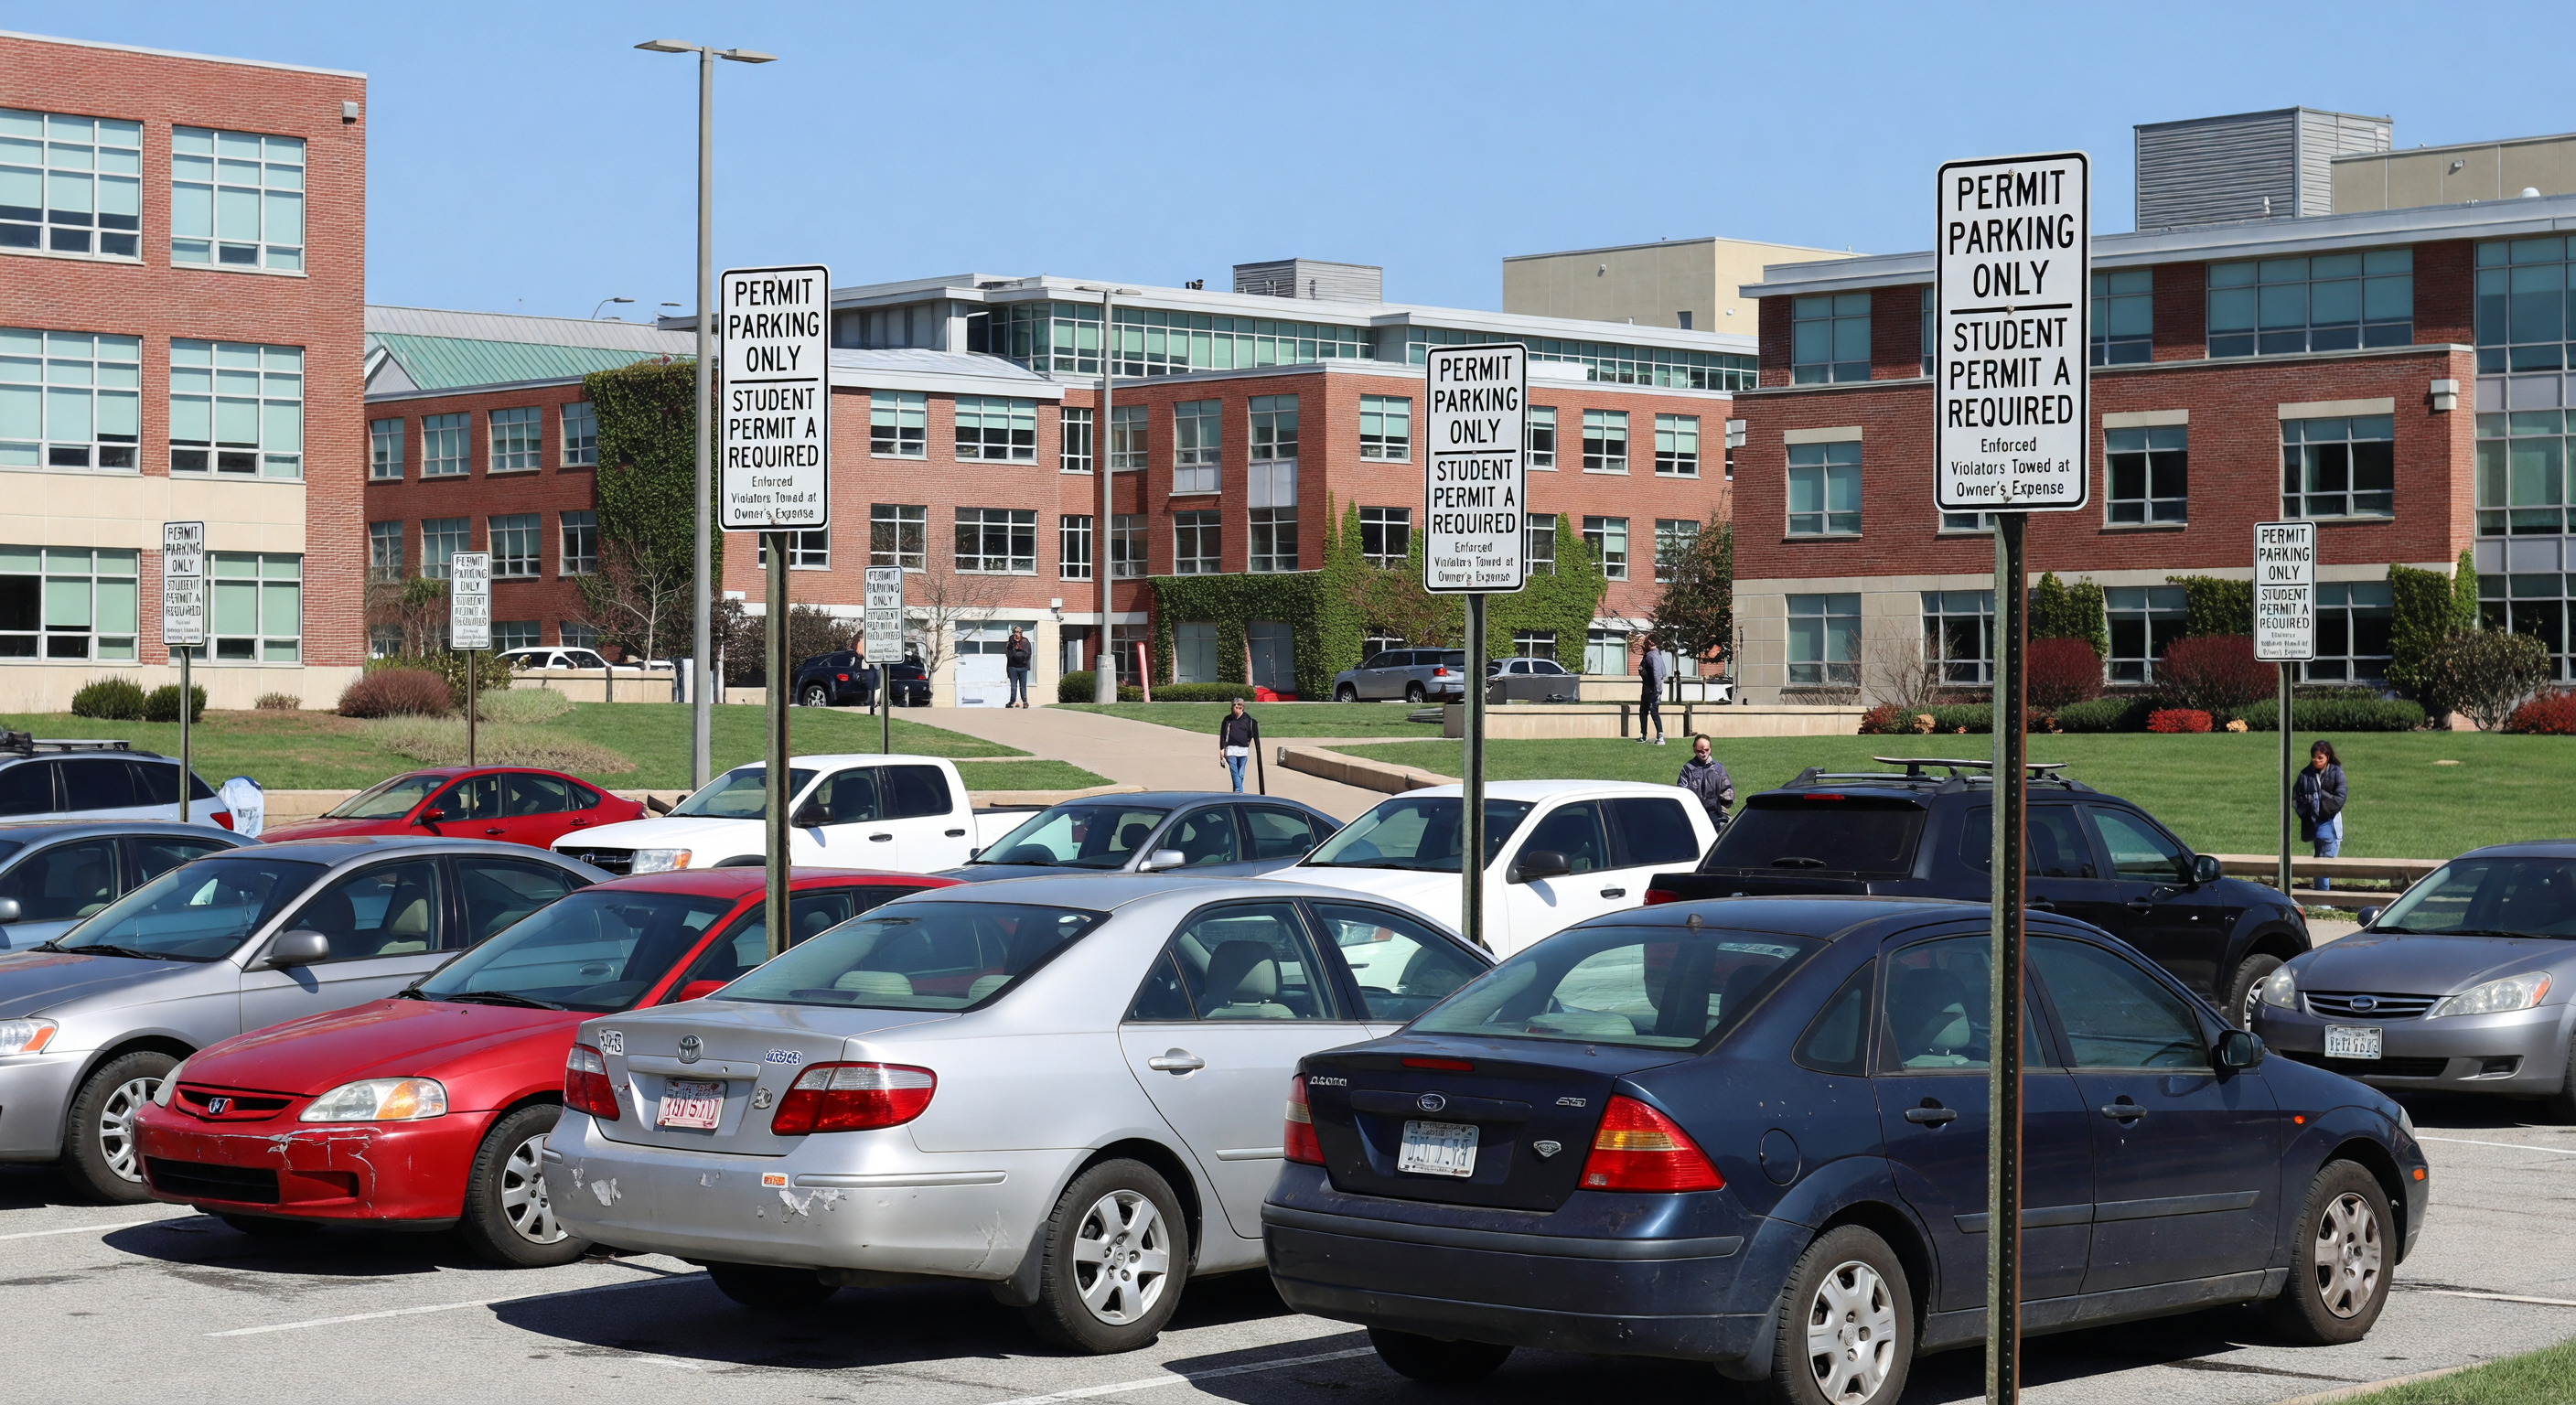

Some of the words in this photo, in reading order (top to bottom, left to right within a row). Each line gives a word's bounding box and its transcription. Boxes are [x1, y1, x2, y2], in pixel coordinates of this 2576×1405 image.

[1958, 169, 2066, 211] PERMIT
[1949, 213, 2074, 255] PARKING
[1973, 259, 2050, 298] ONLY
[735, 278, 813, 306] PERMIT
[729, 311, 819, 339] PARKING
[1953, 317, 2067, 352] STUDENT
[746, 345, 801, 372] ONLY
[1440, 356, 1512, 382] PERMIT
[1950, 357, 2042, 390] PERMIT
[2053, 357, 2071, 386] A
[733, 388, 815, 412] STUDENT
[1434, 387, 1518, 413] PARKING
[1948, 394, 2073, 428] REQUIRED
[730, 417, 796, 440] PERMIT
[805, 416, 817, 438] A
[1450, 418, 1501, 445] ONLY
[1981, 436, 2036, 453] Enforced
[729, 445, 819, 468] REQUIRED
[1951, 461, 2005, 476] Violators
[2012, 458, 2051, 474] Towed
[2057, 458, 2070, 472] at
[1437, 459, 1513, 481] STUDENT
[752, 476, 793, 488] Enforced
[1957, 481, 2007, 497] Owner's
[2012, 480, 2065, 499] Expense
[807, 492, 817, 502] at
[1434, 487, 1496, 508] PERMIT
[1504, 486, 1515, 507] A
[1433, 513, 1516, 534] REQUIRED
[2261, 528, 2306, 543] PERMIT
[166, 542, 201, 556] PARKING
[2259, 547, 2310, 562] PARKING
[172, 559, 194, 573] ONLY
[2269, 565, 2300, 581] ONLY
[460, 581, 480, 592] ONLY
[2261, 588, 2307, 601] STUDENT
[2260, 603, 2296, 616] PERMIT
[2302, 603, 2309, 615] A
